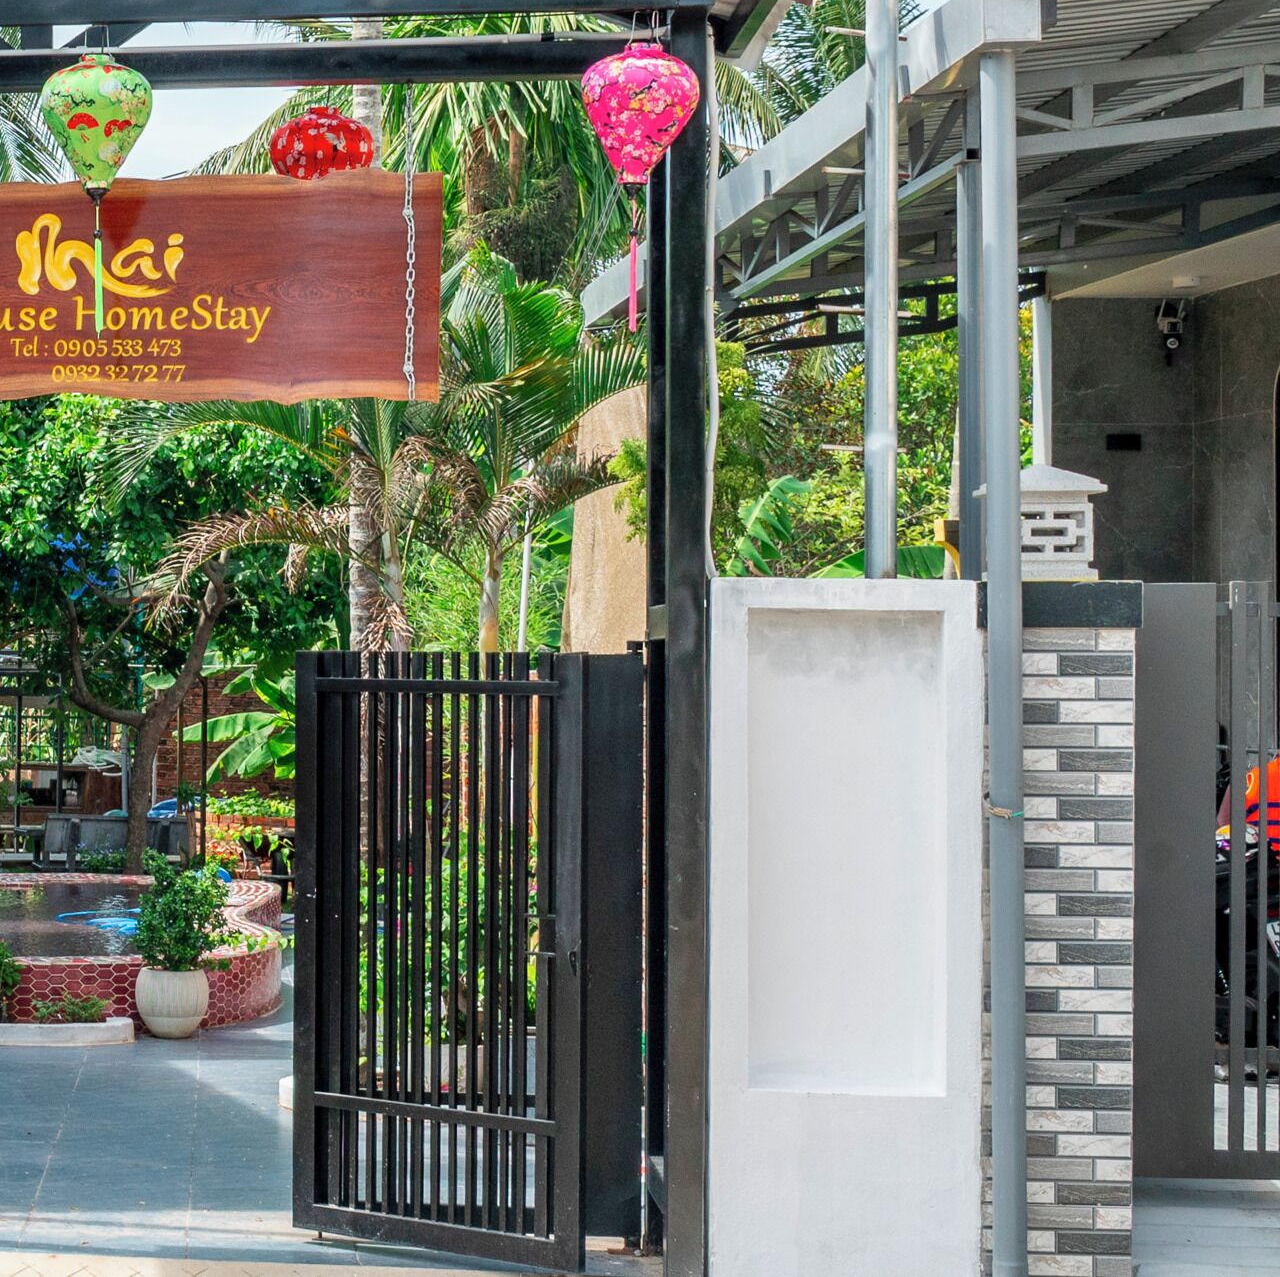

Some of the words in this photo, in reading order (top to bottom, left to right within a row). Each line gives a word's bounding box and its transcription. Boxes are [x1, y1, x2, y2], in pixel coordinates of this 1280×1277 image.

[16, 213, 184, 298] Mai
[72, 294, 271, 343] HomeStay
[54, 339, 108, 357] 0905
[111, 339, 143, 357] 533
[147, 338, 181, 357] 473
[51, 364, 101, 383] 0932
[105, 365, 129, 383] 32
[132, 365, 158, 383] 72
[162, 364, 186, 383] 77
